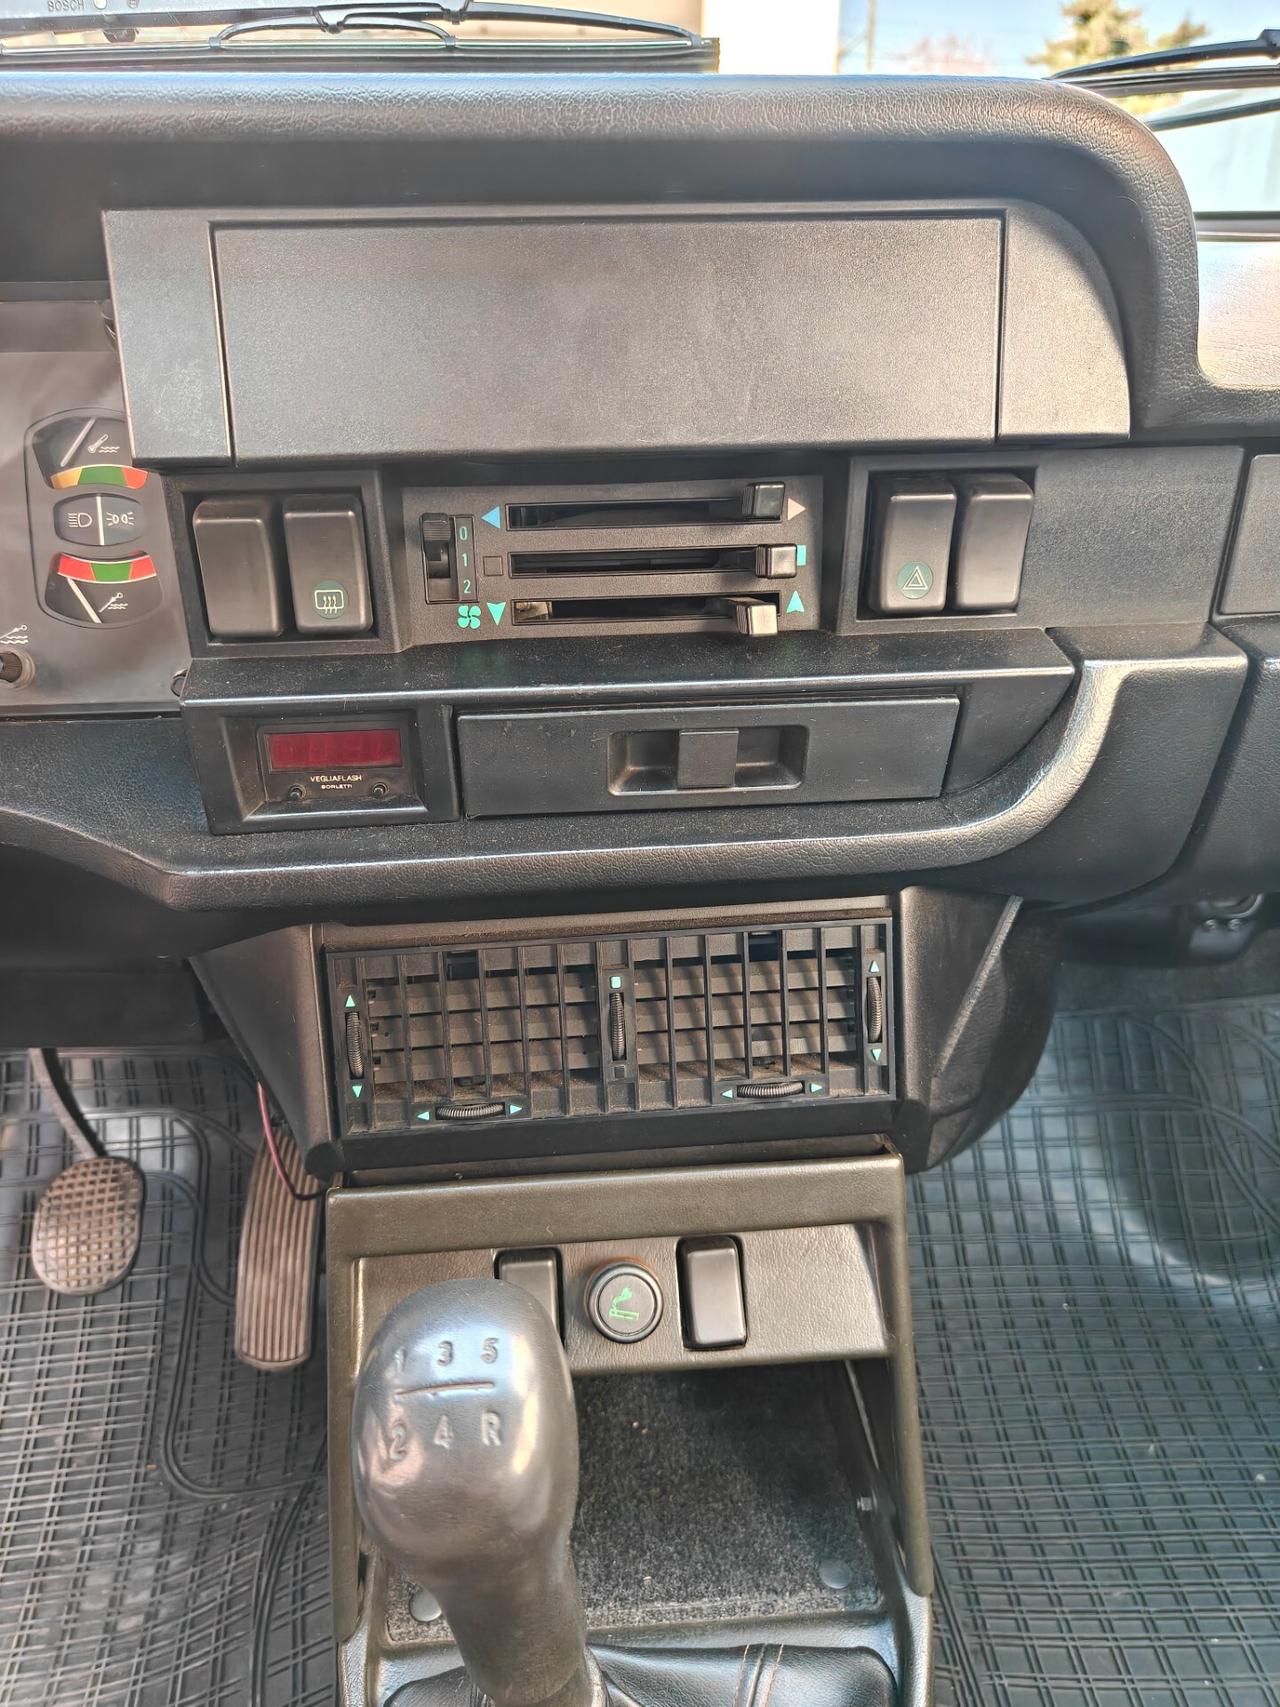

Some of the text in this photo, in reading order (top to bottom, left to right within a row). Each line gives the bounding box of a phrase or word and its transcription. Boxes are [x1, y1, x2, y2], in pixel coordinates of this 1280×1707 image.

[47, 0, 84, 12] BOSCH
[459, 526, 469, 541] 0
[462, 553, 468, 567] 1
[463, 579, 472, 594] 2
[436, 1340, 454, 1366] 3
[480, 1337, 499, 1364] 5
[433, 1414, 455, 1449] 4
[480, 1408, 502, 1447] R
